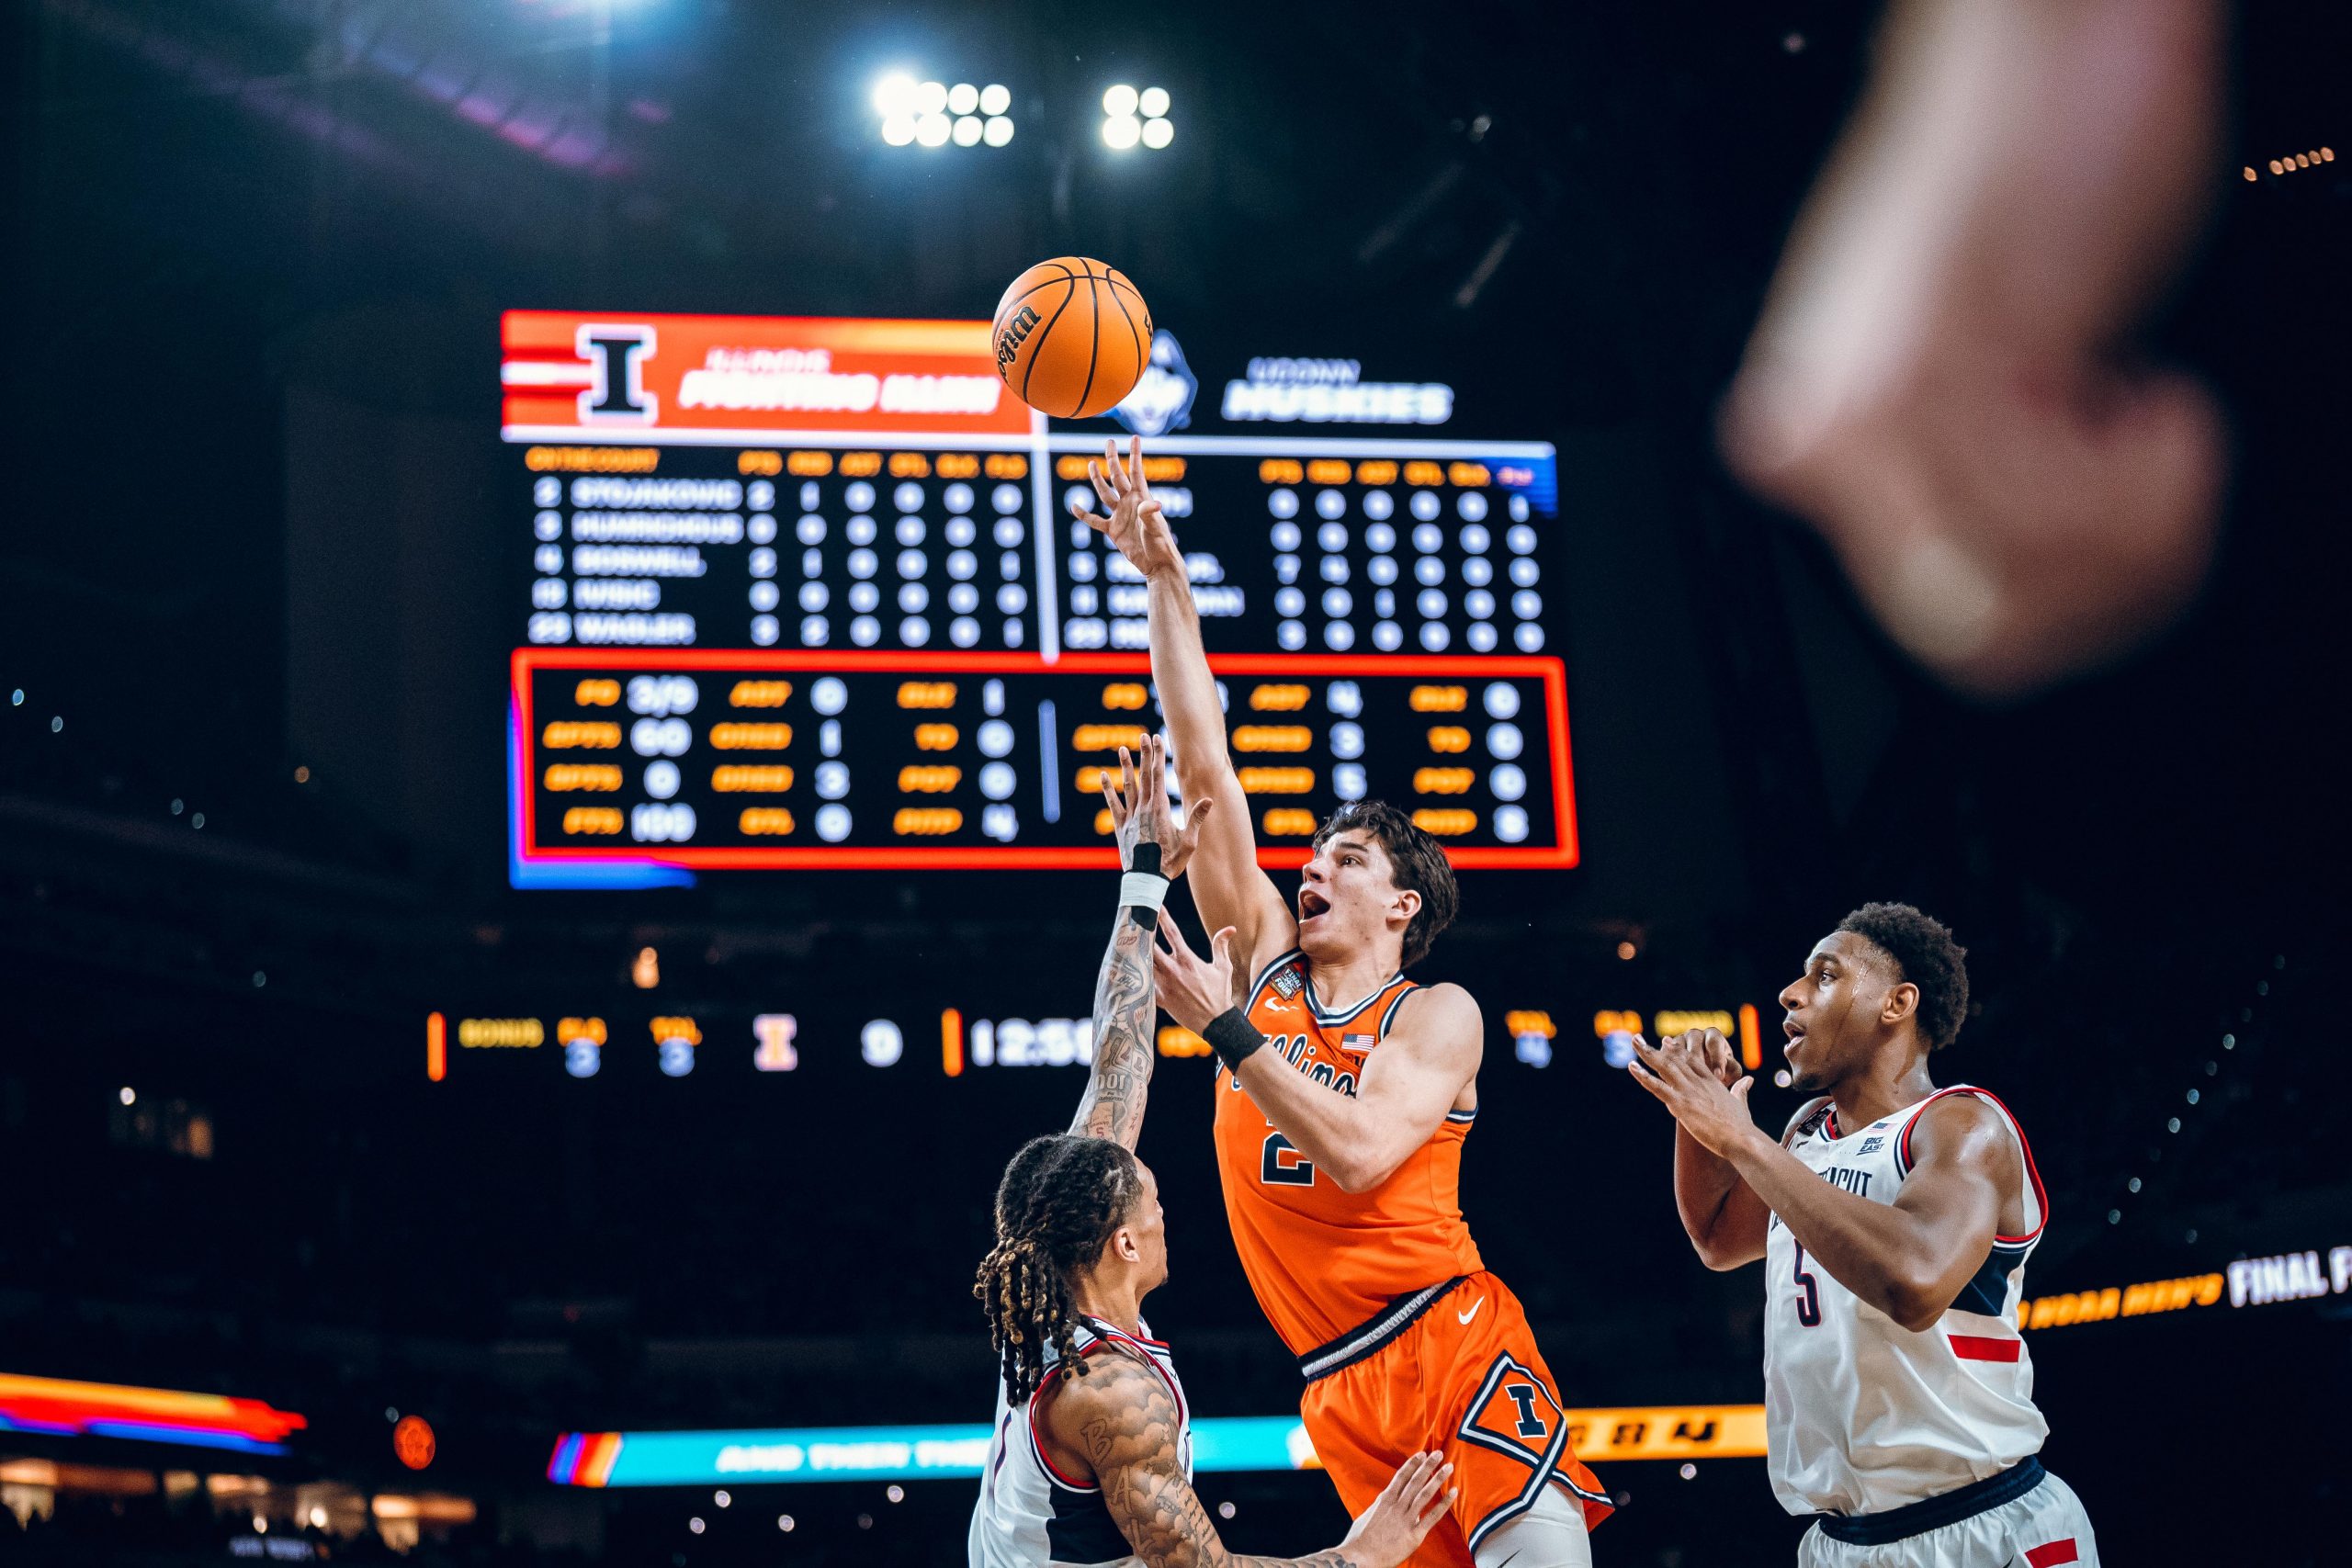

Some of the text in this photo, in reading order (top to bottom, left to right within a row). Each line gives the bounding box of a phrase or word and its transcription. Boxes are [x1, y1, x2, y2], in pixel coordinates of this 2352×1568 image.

[1247, 356, 1361, 384] UCONN
[1222, 379, 1454, 423] HUSKIES
[572, 545, 707, 577] BOSWELL
[1273, 554, 1301, 584] 7
[1275, 977, 1292, 996] FOUR
[1285, 968, 1302, 987] FINAL
[459, 1019, 544, 1047] BONUS
[861, 1020, 903, 1067] 9
[1860, 1144, 1885, 1153] EAST
[1864, 1136, 1884, 1145] BIG
[1793, 1237, 1822, 1327] 5
[2030, 1287, 2120, 1329] NCAA
[2228, 1251, 2328, 1307] FINAL
[1504, 1383, 1548, 1438] I
